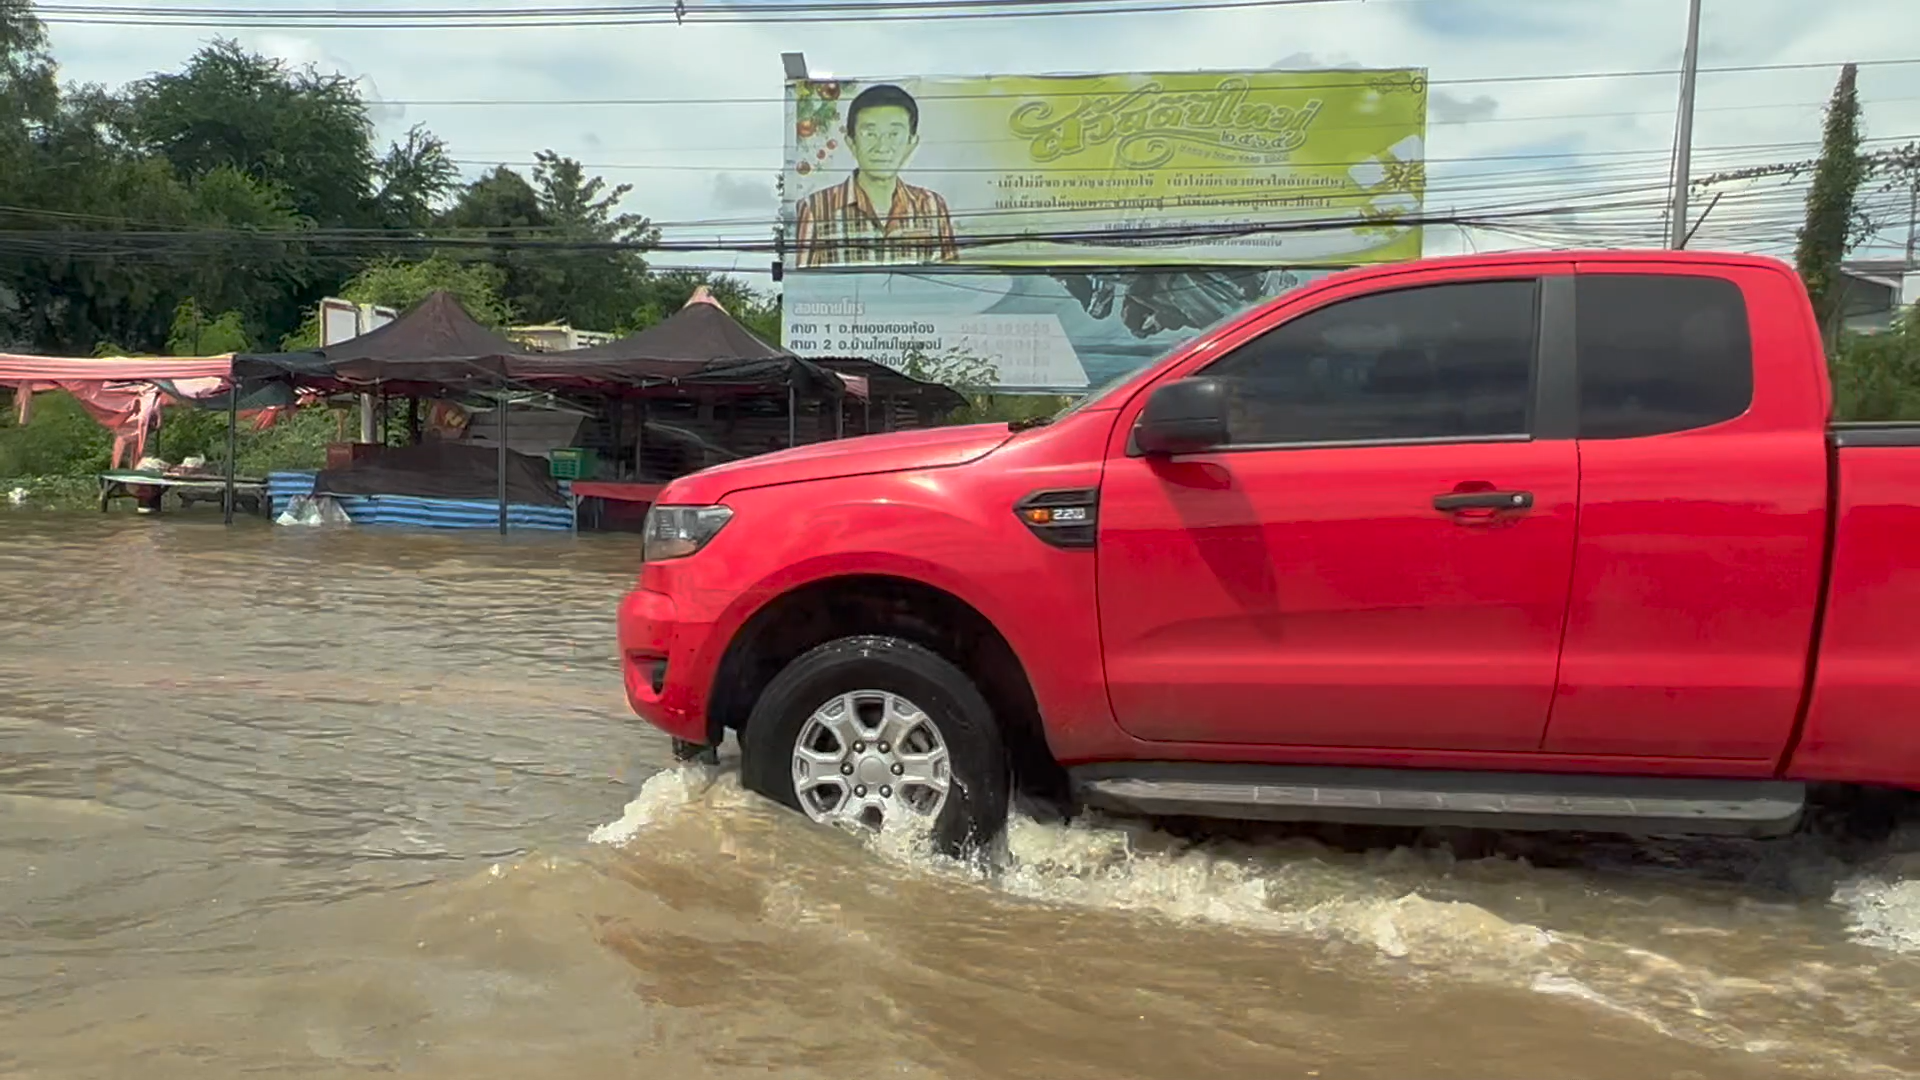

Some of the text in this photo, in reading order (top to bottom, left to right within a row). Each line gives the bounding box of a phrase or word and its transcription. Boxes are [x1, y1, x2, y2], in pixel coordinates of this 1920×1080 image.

[790, 320, 935, 334] สาขา 1 อ.หนองสองห้อง
[789, 338, 817, 350] สาขา
[823, 339, 832, 350] 2
